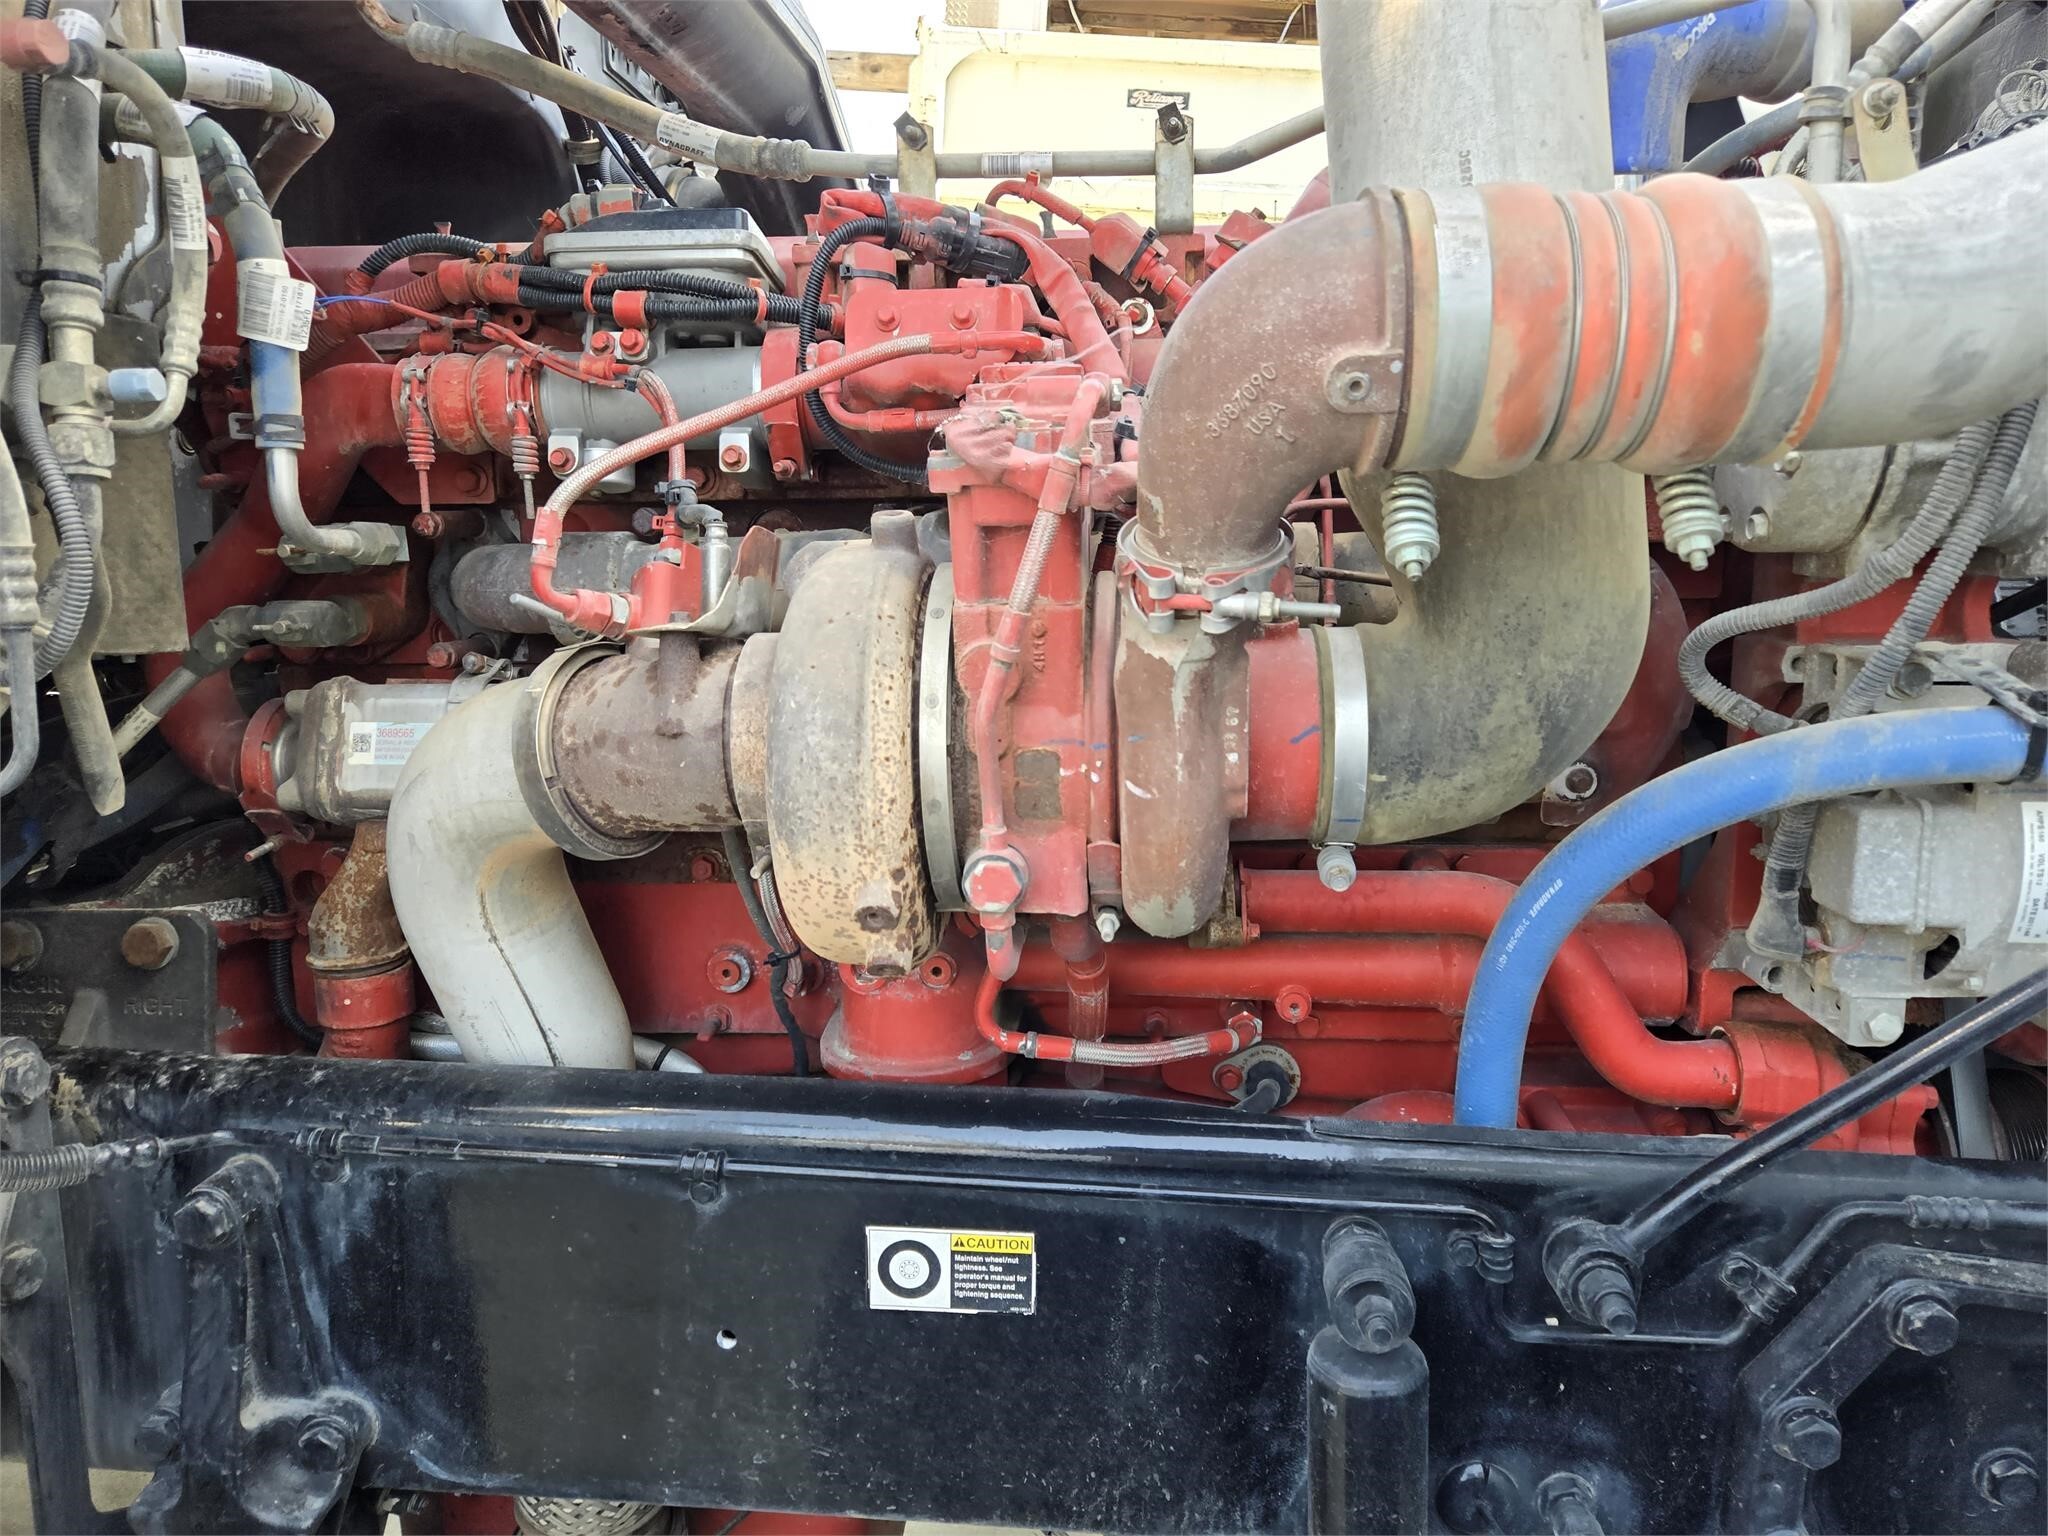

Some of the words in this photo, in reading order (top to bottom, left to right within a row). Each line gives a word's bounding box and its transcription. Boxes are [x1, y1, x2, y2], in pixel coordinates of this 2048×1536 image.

[1246, 401, 1287, 435] USA
[966, 1237, 1029, 1250] CAUTION
[954, 1254, 984, 1263] Maintain
[985, 1256, 1019, 1265] wheel/nut
[954, 1263, 988, 1273] tightness.
[989, 1265, 1003, 1273] See
[954, 1273, 989, 1282] operator's
[990, 1274, 1016, 1282] manual
[1016, 1275, 1027, 1283] for
[954, 1282, 977, 1291] proper
[978, 1282, 1001, 1291] torque
[1002, 1283, 1016, 1291] and
[954, 1290, 989, 1300] tightening
[990, 1292, 1025, 1301] sequence.
